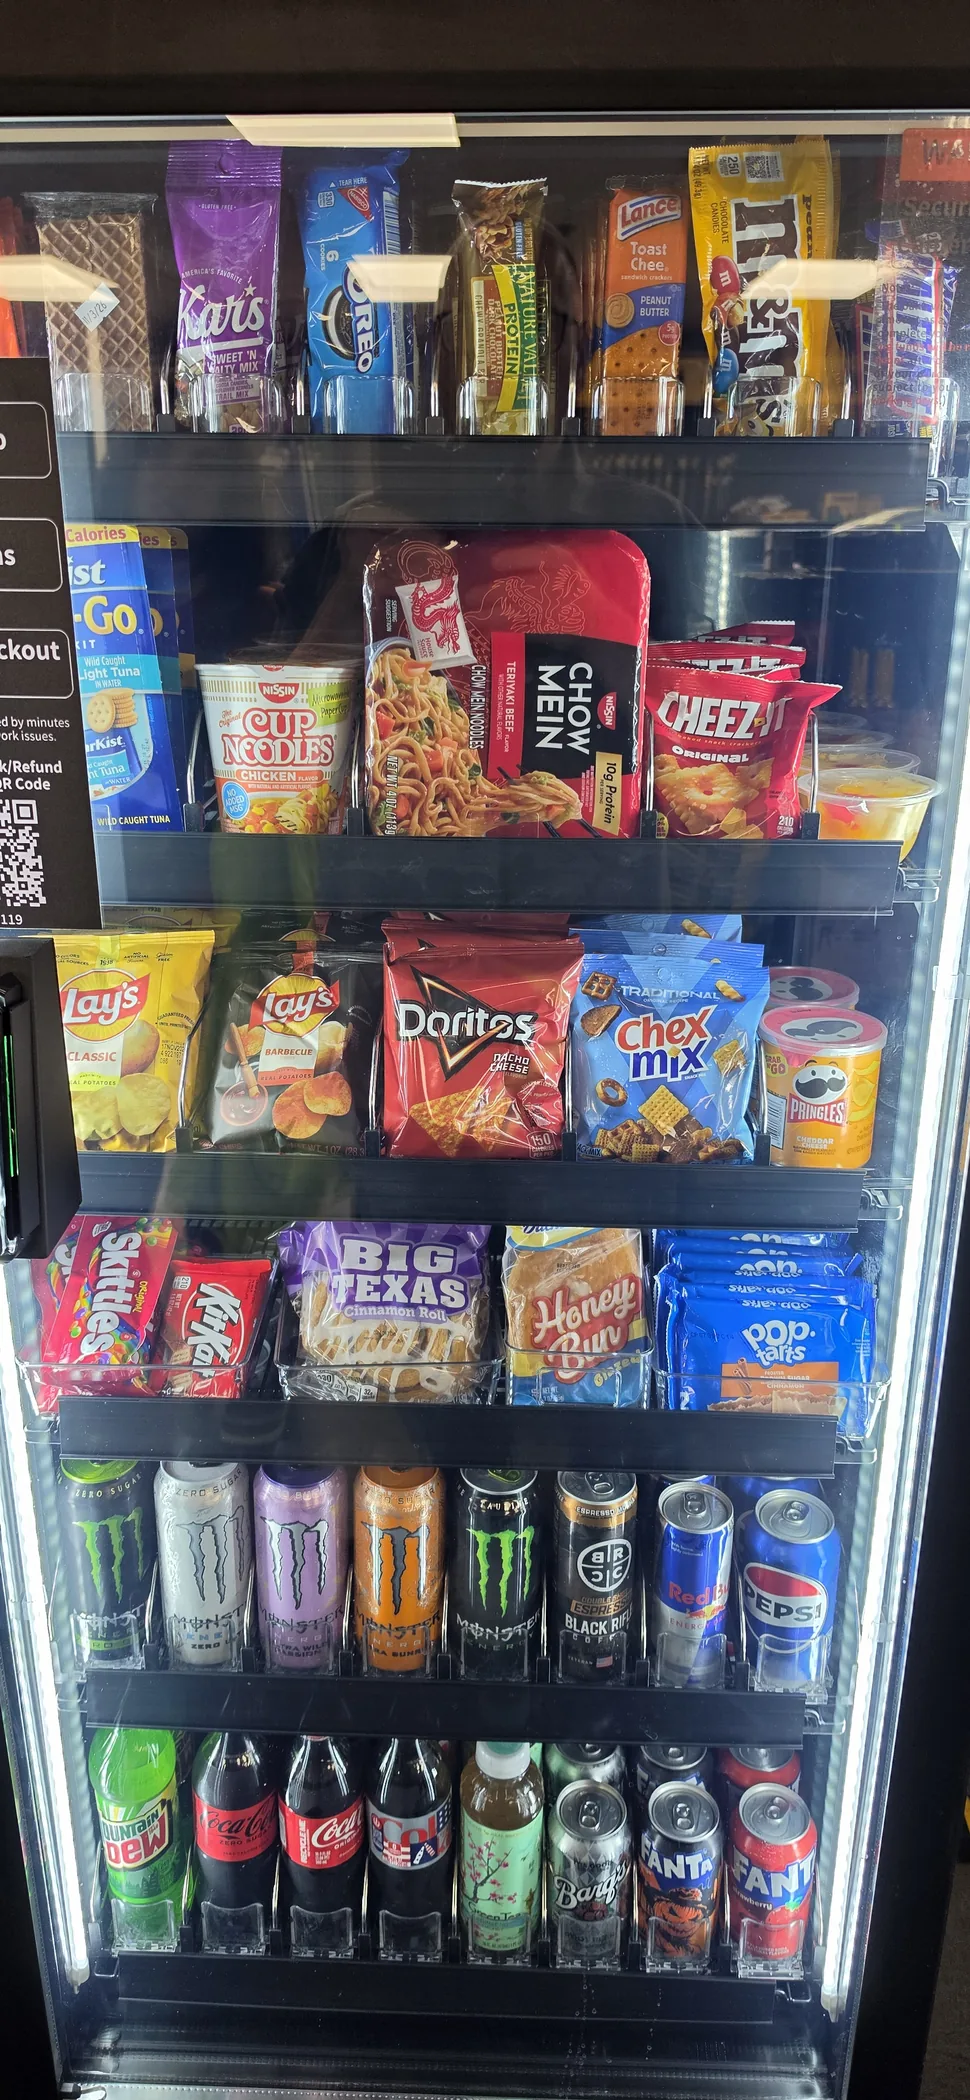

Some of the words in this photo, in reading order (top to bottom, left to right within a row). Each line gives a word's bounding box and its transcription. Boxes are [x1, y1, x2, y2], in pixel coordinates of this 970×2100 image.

[727, 156, 740, 175] 250
[339, 179, 352, 187] TEAR
[620, 198, 678, 229] Lance
[711, 202, 720, 235] CANDIES
[719, 201, 730, 244] CHOCOLATE
[515, 220, 524, 242] GLUTEN
[326, 250, 339, 262] 6
[630, 241, 668, 256] Toast
[630, 257, 665, 271] Chee
[181, 267, 215, 280] AMERICA'S
[216, 269, 243, 285] FAVORITE
[719, 270, 732, 287] m
[475, 294, 483, 323] CHEWY
[516, 268, 537, 340] NATURE
[640, 296, 672, 305] PEANUT
[344, 266, 374, 374] OREO
[488, 299, 497, 326] DARK
[493, 300, 503, 338] PEANUT
[640, 307, 670, 317] BUTTER
[475, 326, 484, 365] GRANOLA
[503, 302, 520, 375] PROTEIN
[239, 361, 259, 372] MIX
[235, 390, 249, 399] MIX
[65, 525, 127, 543] Calories
[419, 637, 428, 658] Sauce
[425, 637, 434, 657] House
[84, 655, 101, 666] Wild
[101, 655, 126, 667] Caught
[79, 666, 108, 680] Light
[109, 667, 140, 678] Tuna
[471, 664, 487, 688] CHOW
[506, 661, 516, 705] TERIYAKI
[95, 680, 101, 688] IN
[102, 679, 122, 688] WATER
[262, 683, 295, 698] NISSIN
[470, 690, 485, 711] MEIN
[535, 665, 565, 750] MEIN
[566, 661, 593, 755] CHOW
[602, 695, 614, 726] NISSIN
[11, 716, 24, 730] by
[27, 717, 70, 728] minutes
[244, 708, 316, 738] CUP
[505, 708, 515, 732] BEEF
[657, 691, 793, 739] CHEEZ-IT
[21, 730, 57, 742] issues.
[469, 713, 485, 750] NOODLES
[221, 735, 334, 765] NOODLES
[672, 745, 750, 763] ORIGINAL
[101, 763, 126, 776] Tuna
[386, 755, 398, 771] NET
[604, 761, 617, 780] 10g
[15, 777, 51, 791] Code
[240, 770, 297, 782] CHICKEN
[386, 774, 397, 788] WT
[225, 796, 245, 806] ADDED
[227, 788, 237, 797] NO
[386, 796, 396, 808] OZ
[229, 804, 243, 814] MSG
[603, 785, 617, 824] Protein
[97, 815, 117, 826] WILD
[118, 815, 149, 825] CAUGHT
[150, 814, 171, 824] TUNA
[778, 815, 794, 827] 210
[619, 985, 720, 1000] TRADITIONAL
[63, 981, 139, 1026] Lay's
[262, 986, 334, 1024] Lay's
[399, 1002, 536, 1041] Doritos
[617, 1008, 712, 1050] Chex
[67, 1051, 117, 1062] CLASSIC
[265, 1048, 313, 1056] BARBECUE
[493, 1053, 530, 1065] NACHO
[489, 1063, 529, 1075] CHEESE
[791, 1098, 846, 1125] PRINGLES
[530, 1133, 551, 1146] 150
[796, 1136, 834, 1145] CHEDDAR
[342, 1239, 455, 1274] BIG
[80, 1231, 143, 1355] Skittles
[180, 1276, 190, 1290] 210
[332, 1273, 466, 1308] TEXAS
[344, 1305, 416, 1319] Cinnamon
[416, 1307, 447, 1322] Roll
[533, 1278, 637, 1344] Honey
[186, 1282, 241, 1379] KitKat
[546, 1324, 622, 1380] Bun
[75, 1486, 103, 1499] ZERO
[110, 1473, 142, 1496] SUGAR
[175, 1486, 207, 1498] ZERO
[212, 1468, 243, 1495] SUGAR
[575, 1506, 616, 1517] ESPRESSO
[668, 1580, 711, 1605] Red
[743, 1580, 823, 1624] PEPSI
[565, 1613, 608, 1636] BLACK
[670, 1617, 710, 1631] ENERGY
[640, 1832, 713, 1880] FANTA
[553, 1859, 627, 1910] Barq's
[468, 1900, 501, 1920] Green
